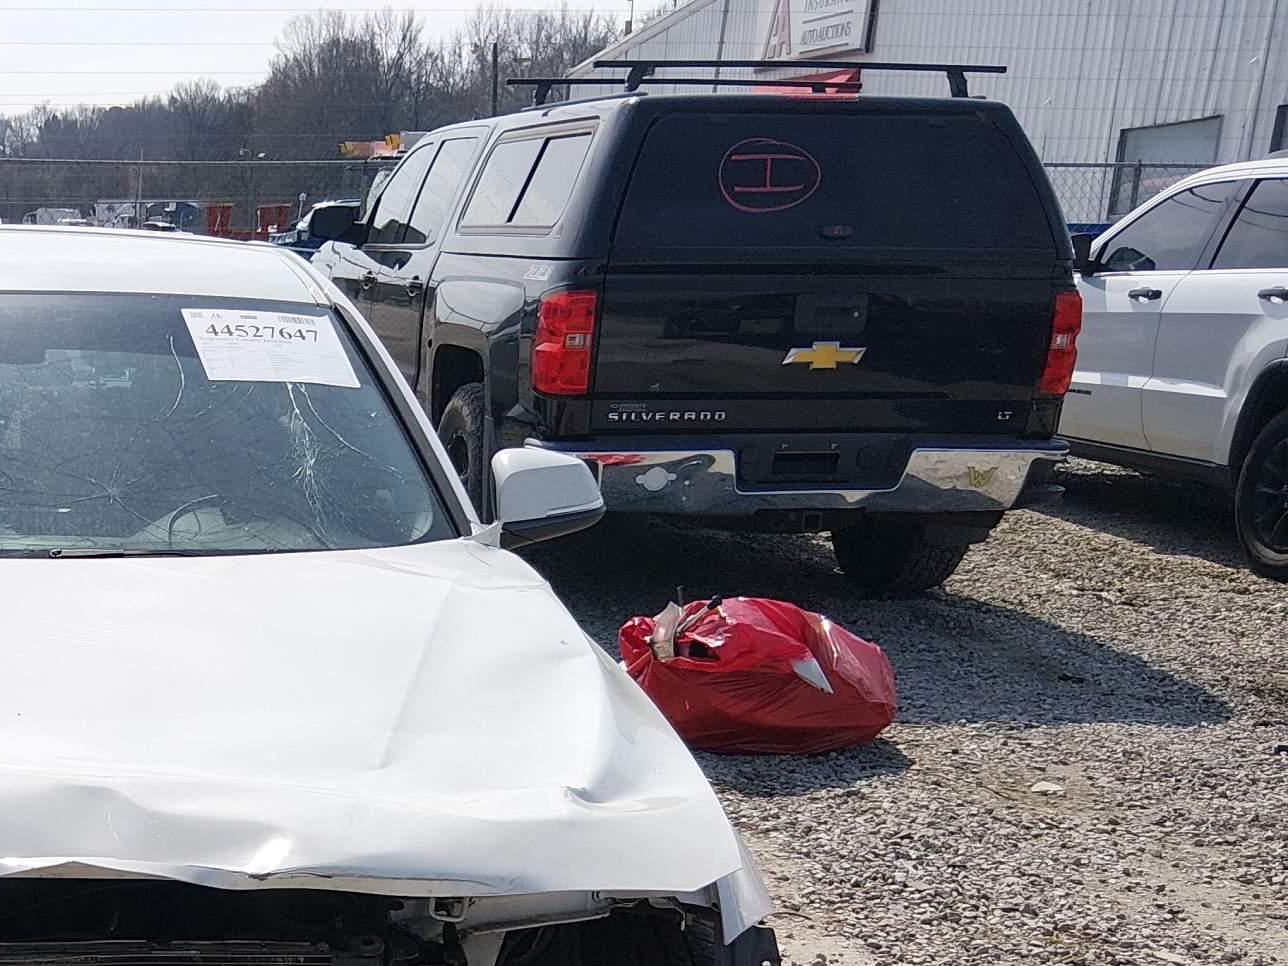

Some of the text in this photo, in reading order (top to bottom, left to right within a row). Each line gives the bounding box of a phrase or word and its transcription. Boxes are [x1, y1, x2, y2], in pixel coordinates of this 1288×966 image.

[205, 323, 318, 343] 44527647
[608, 411, 726, 421] SILVERADO
[997, 410, 1013, 420] LT
